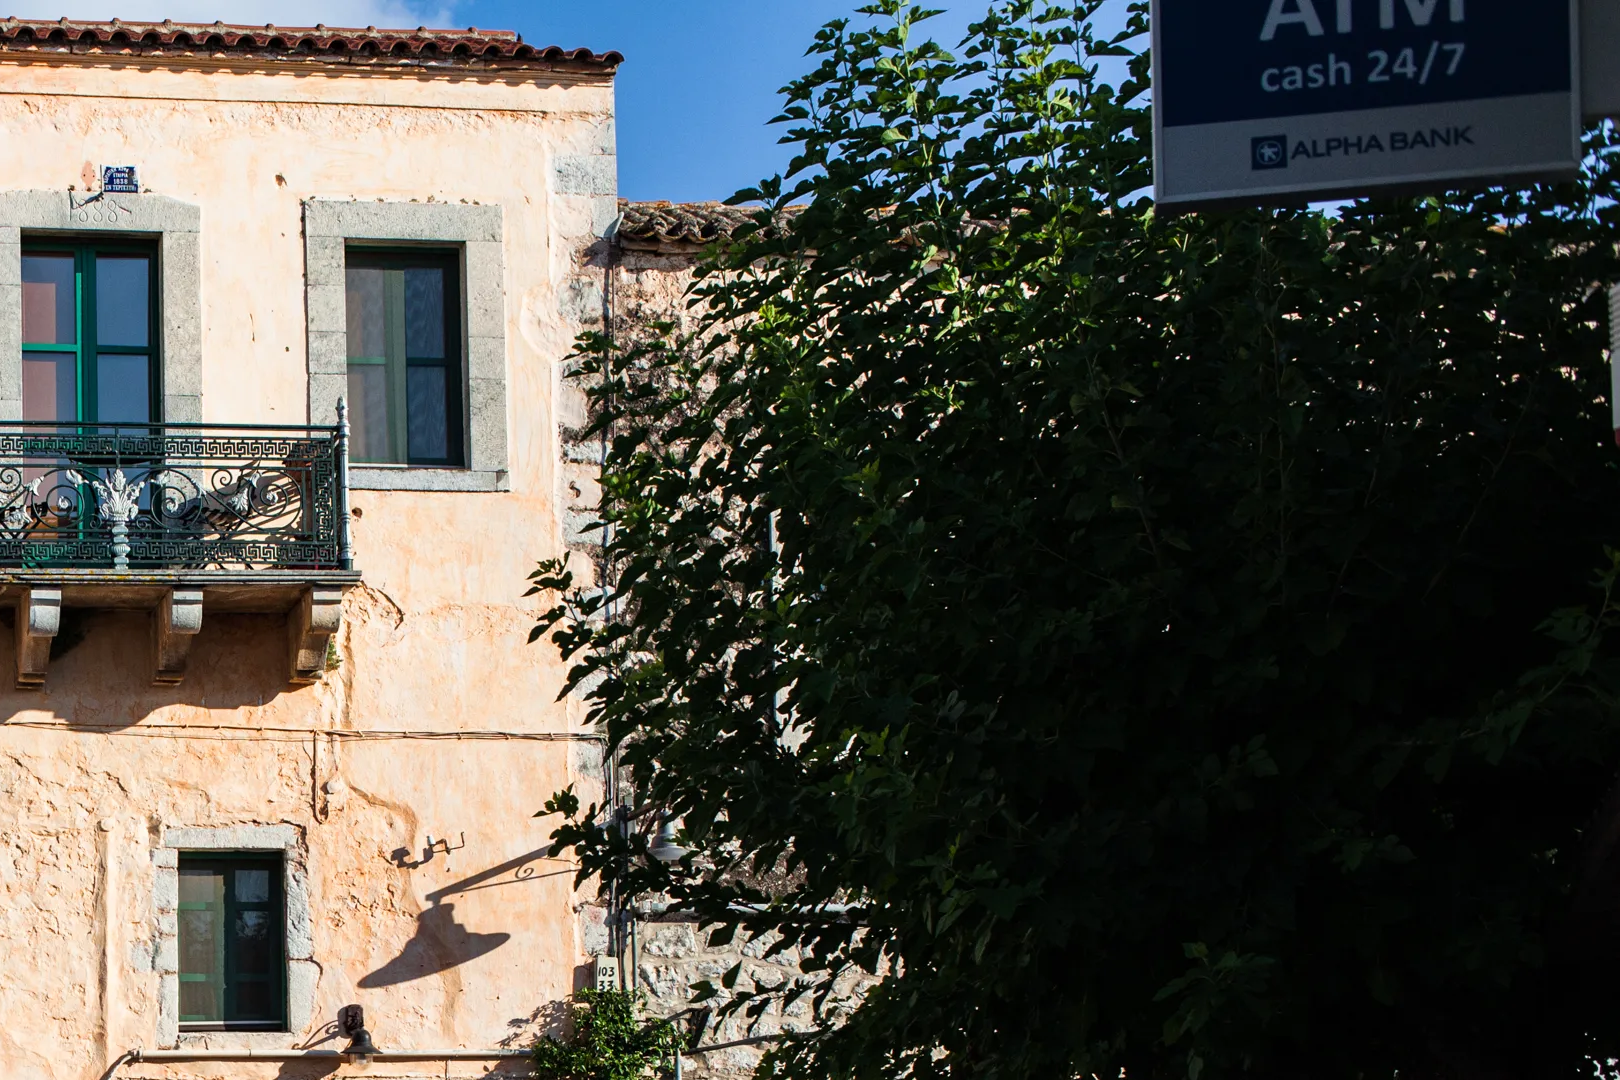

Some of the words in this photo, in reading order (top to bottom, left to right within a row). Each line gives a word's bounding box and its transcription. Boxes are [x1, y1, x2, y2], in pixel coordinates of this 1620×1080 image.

[1261, 52, 1352, 93] cash
[1367, 40, 1466, 85] 24/7
[1291, 133, 1384, 160] ALPHA
[1390, 126, 1474, 152] BANK
[598, 966, 615, 978] 103
